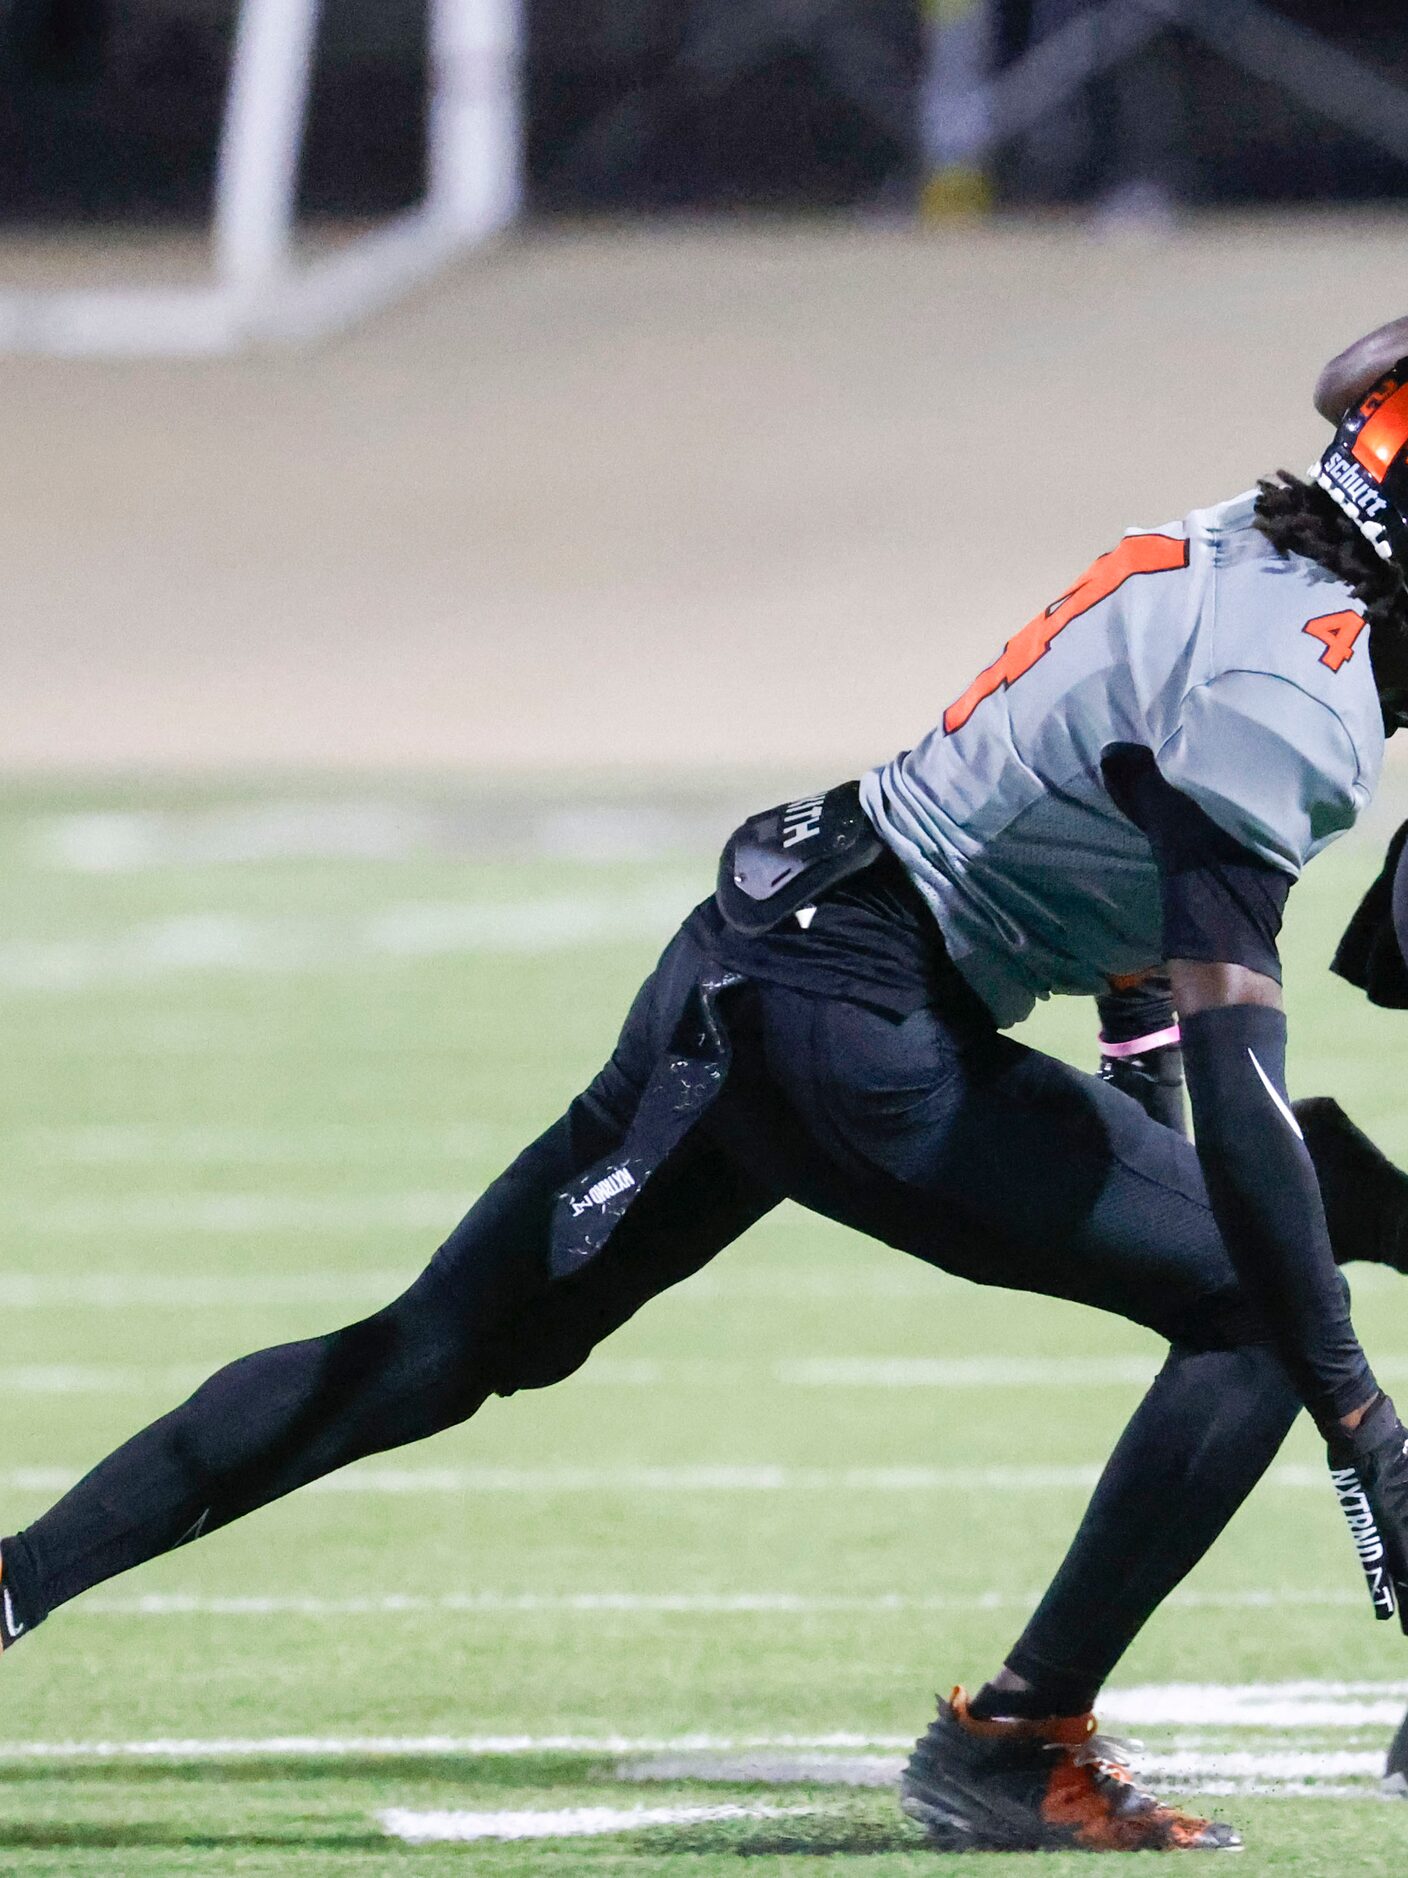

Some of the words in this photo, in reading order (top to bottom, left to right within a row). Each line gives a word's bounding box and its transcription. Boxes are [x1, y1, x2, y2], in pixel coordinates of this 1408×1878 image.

[1324, 452, 1387, 517] schutt
[1301, 608, 1367, 674] 4
[1331, 1466, 1384, 1563] NXTRND
